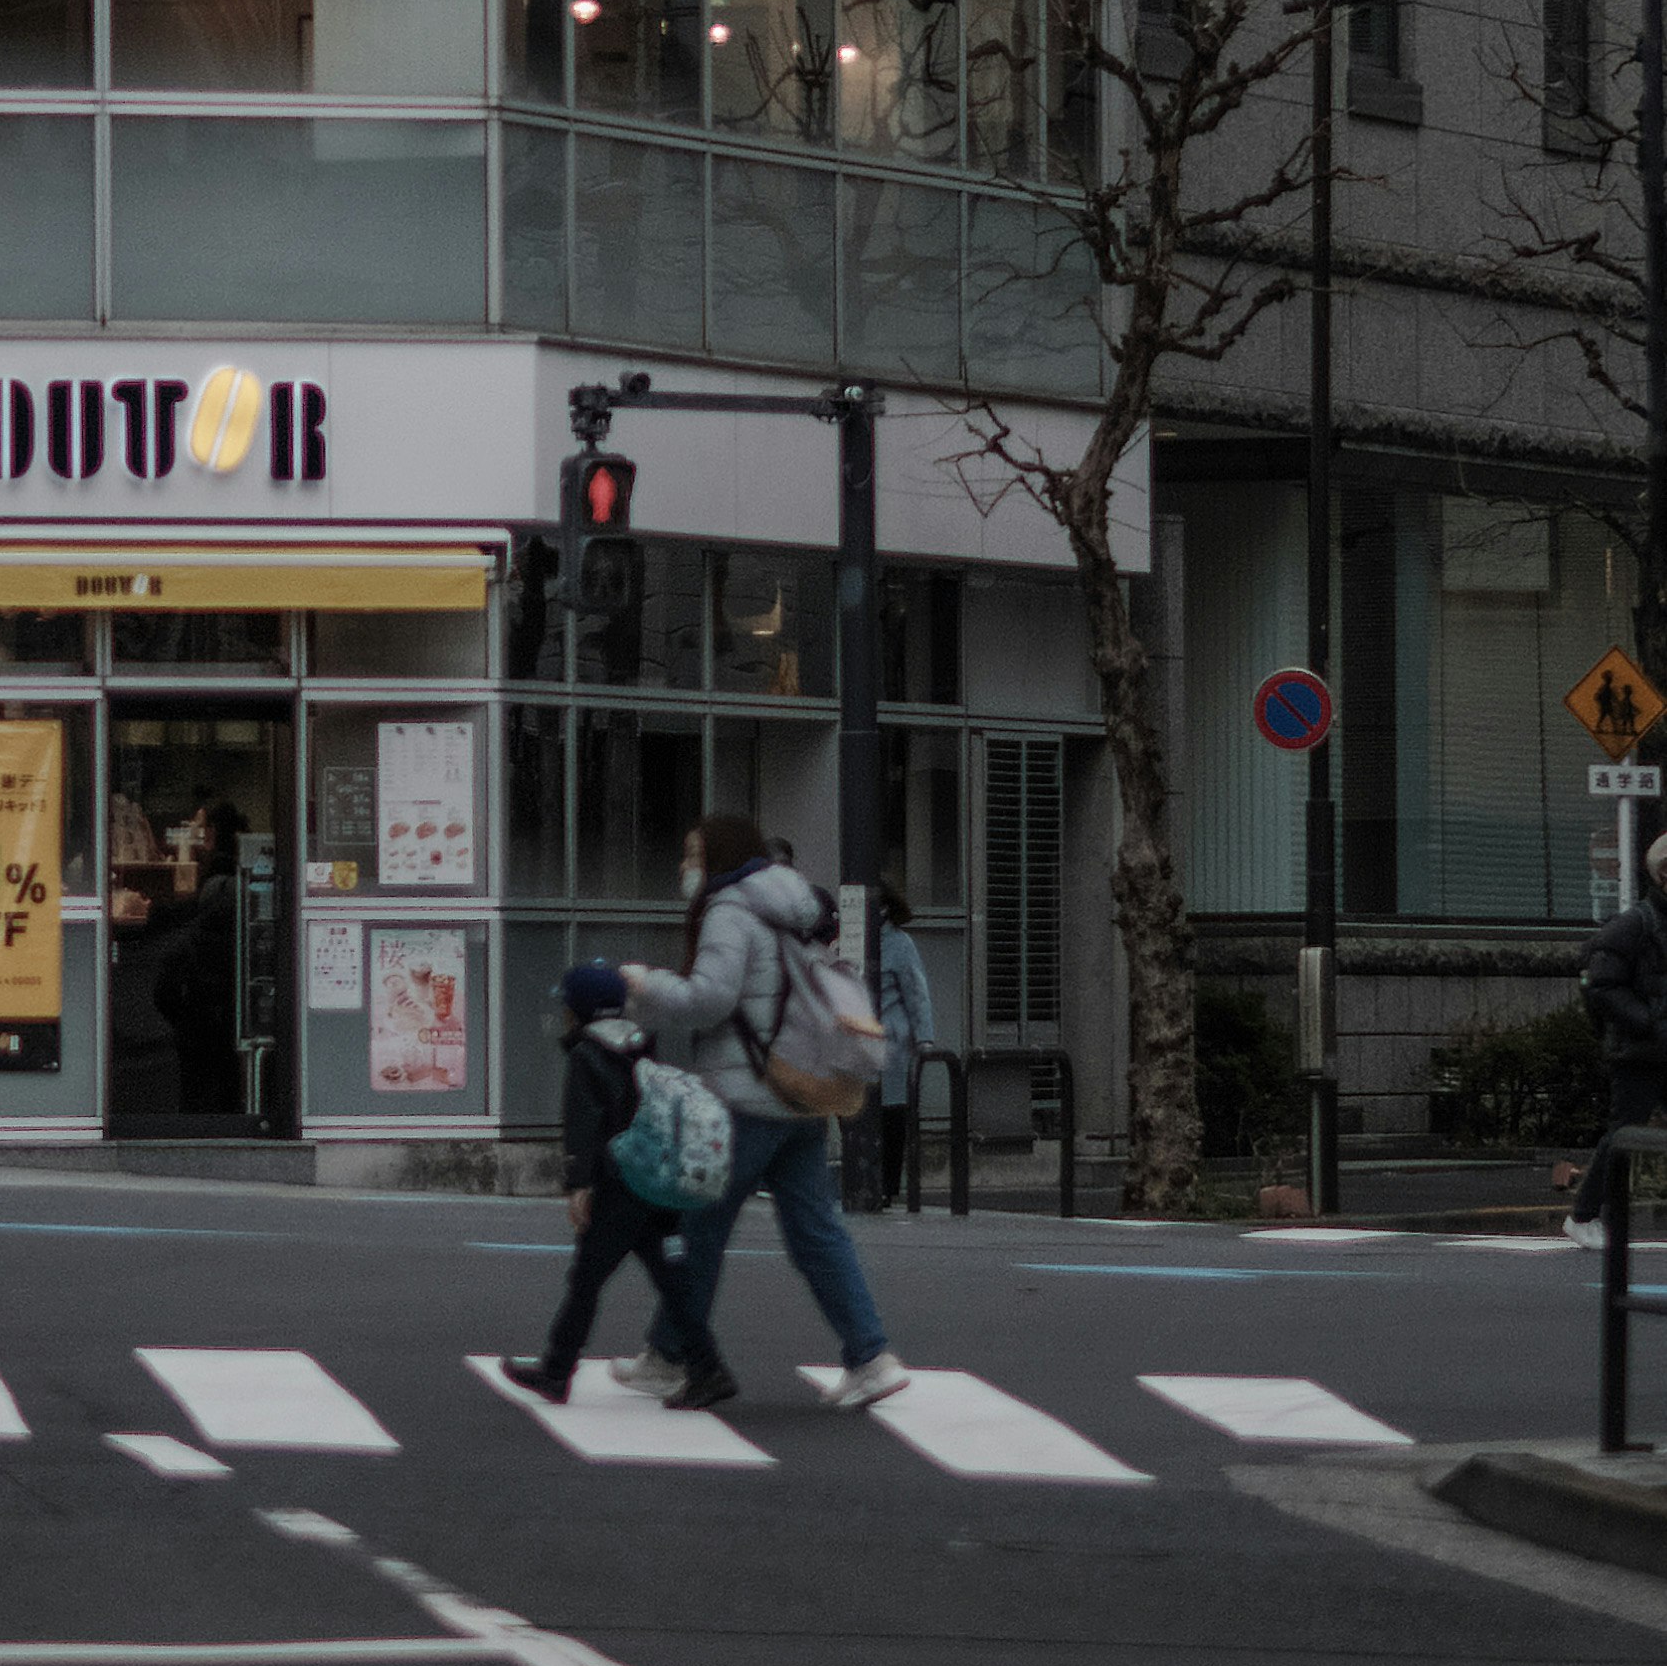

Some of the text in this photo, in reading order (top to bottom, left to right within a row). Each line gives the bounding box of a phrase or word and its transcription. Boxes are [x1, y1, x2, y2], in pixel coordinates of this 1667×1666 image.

[75, 572, 163, 596] DOUTOR
[1594, 772, 1655, 789] 通学路
